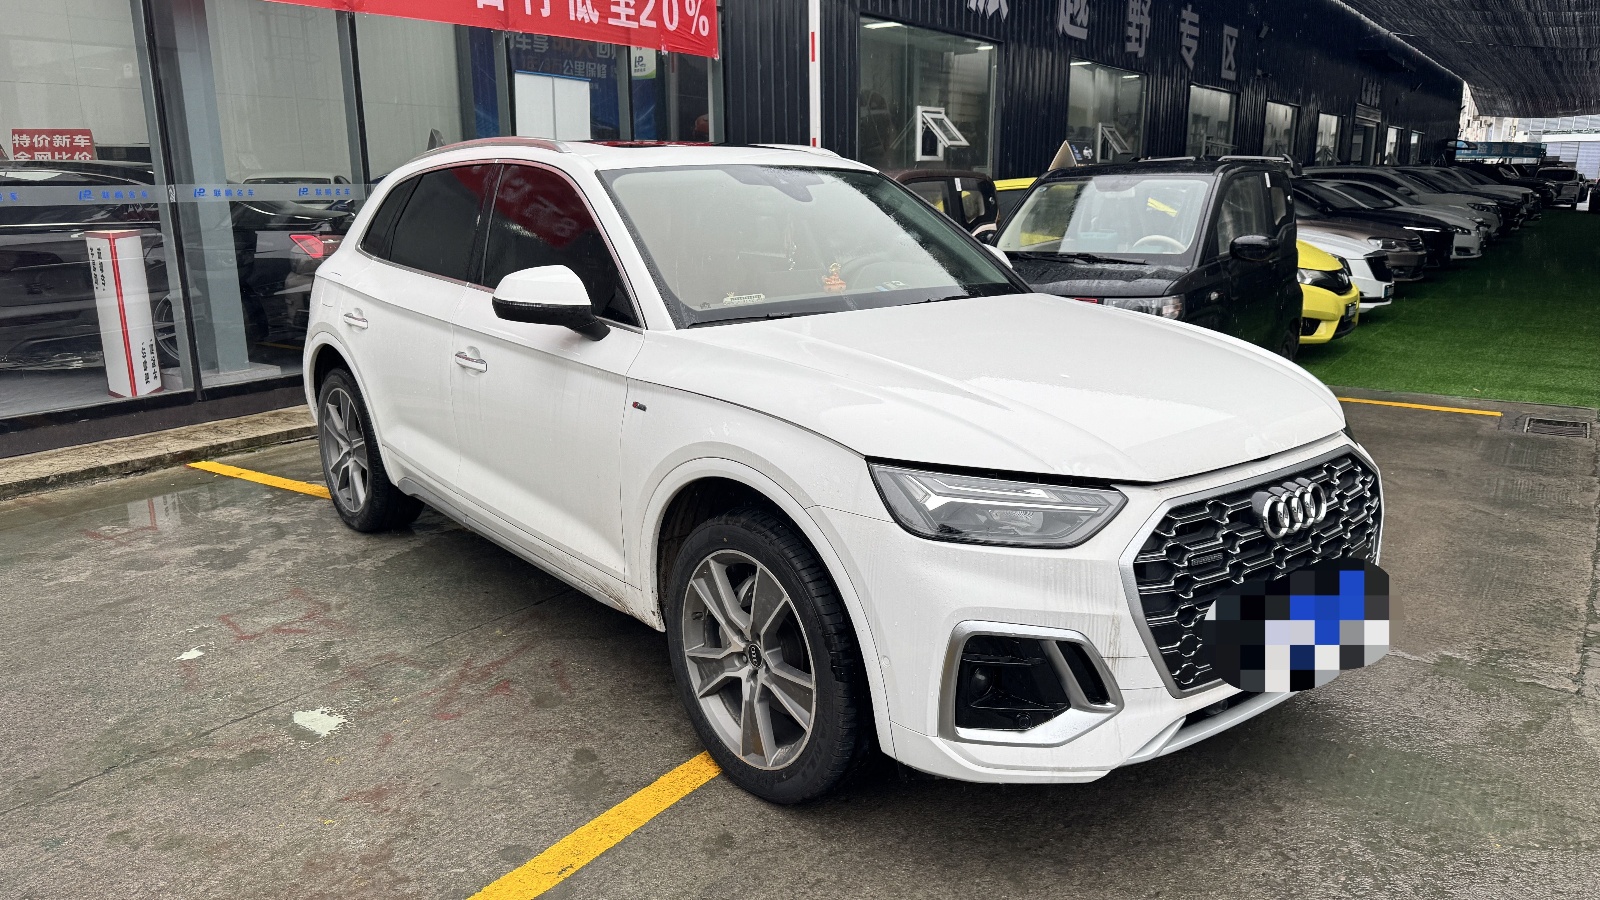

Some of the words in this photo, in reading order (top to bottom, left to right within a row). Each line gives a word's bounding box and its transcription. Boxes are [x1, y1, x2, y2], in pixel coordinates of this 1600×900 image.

[476, 0, 710, 37] 低至20%
[12, 133, 92, 148] 特价新车
